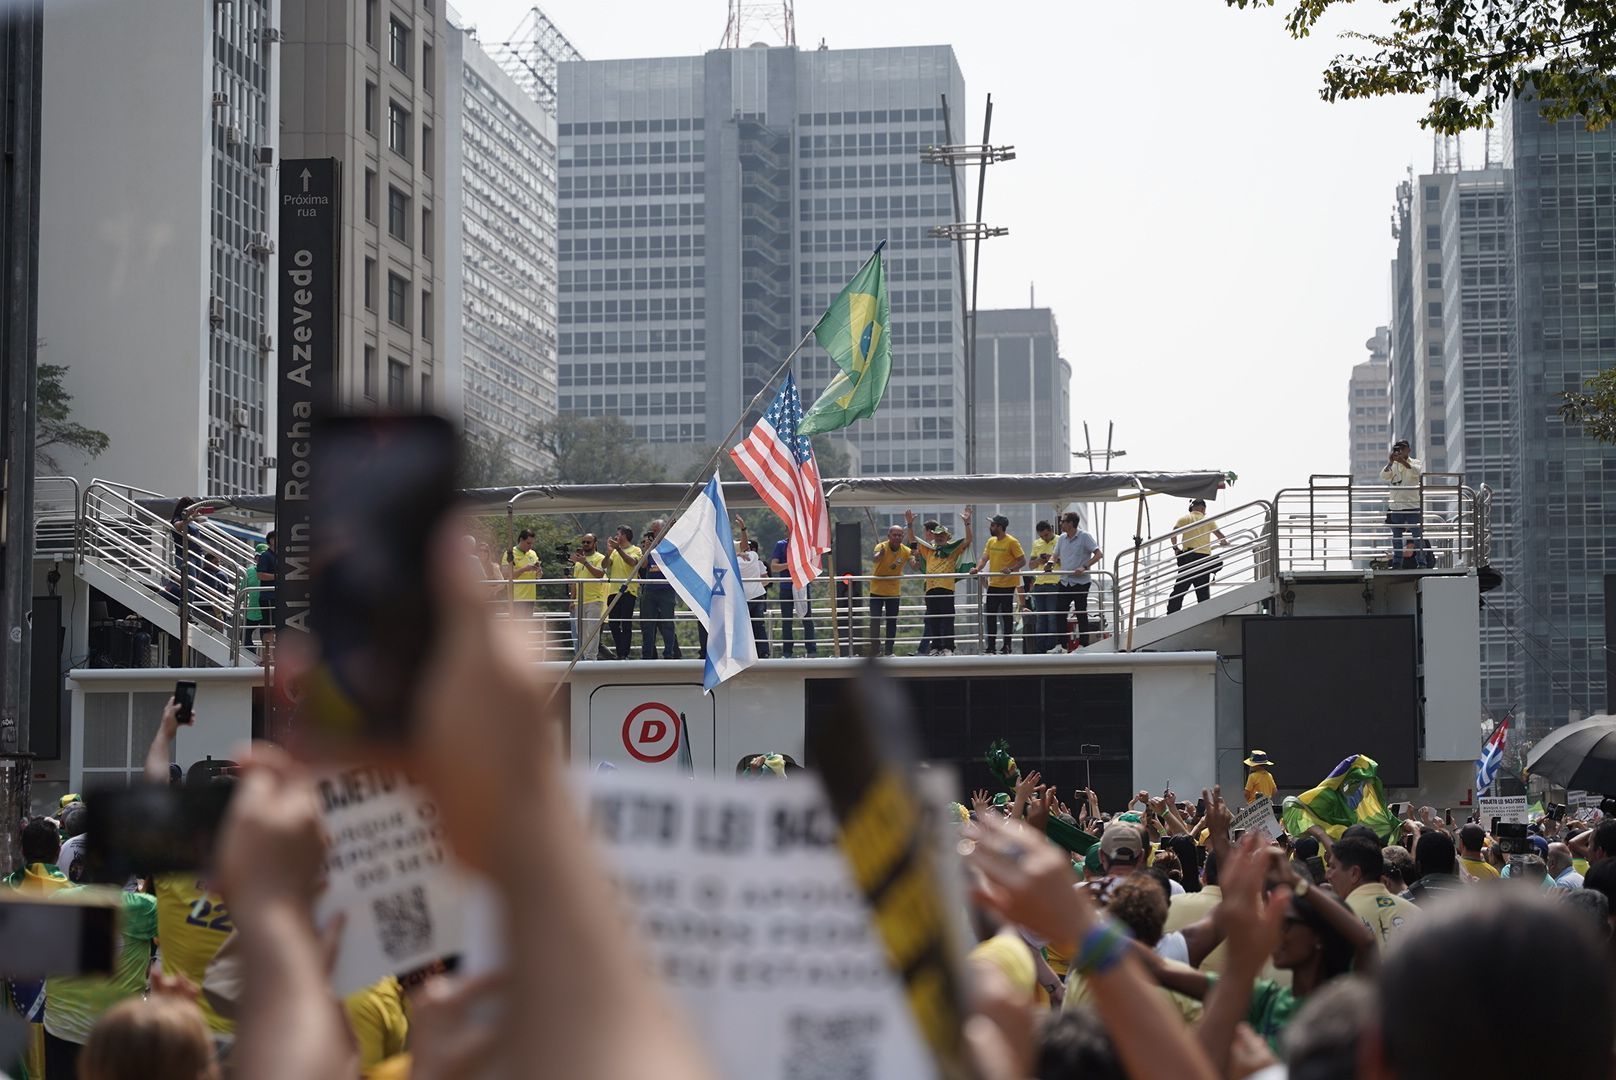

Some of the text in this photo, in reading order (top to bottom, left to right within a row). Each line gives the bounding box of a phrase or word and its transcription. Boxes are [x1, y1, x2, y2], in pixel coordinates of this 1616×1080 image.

[284, 194, 328, 205] Próxima
[297, 208, 317, 217] rua
[285, 250, 313, 633] Al. Min. Rocha Azevedo
[639, 720, 667, 743] D
